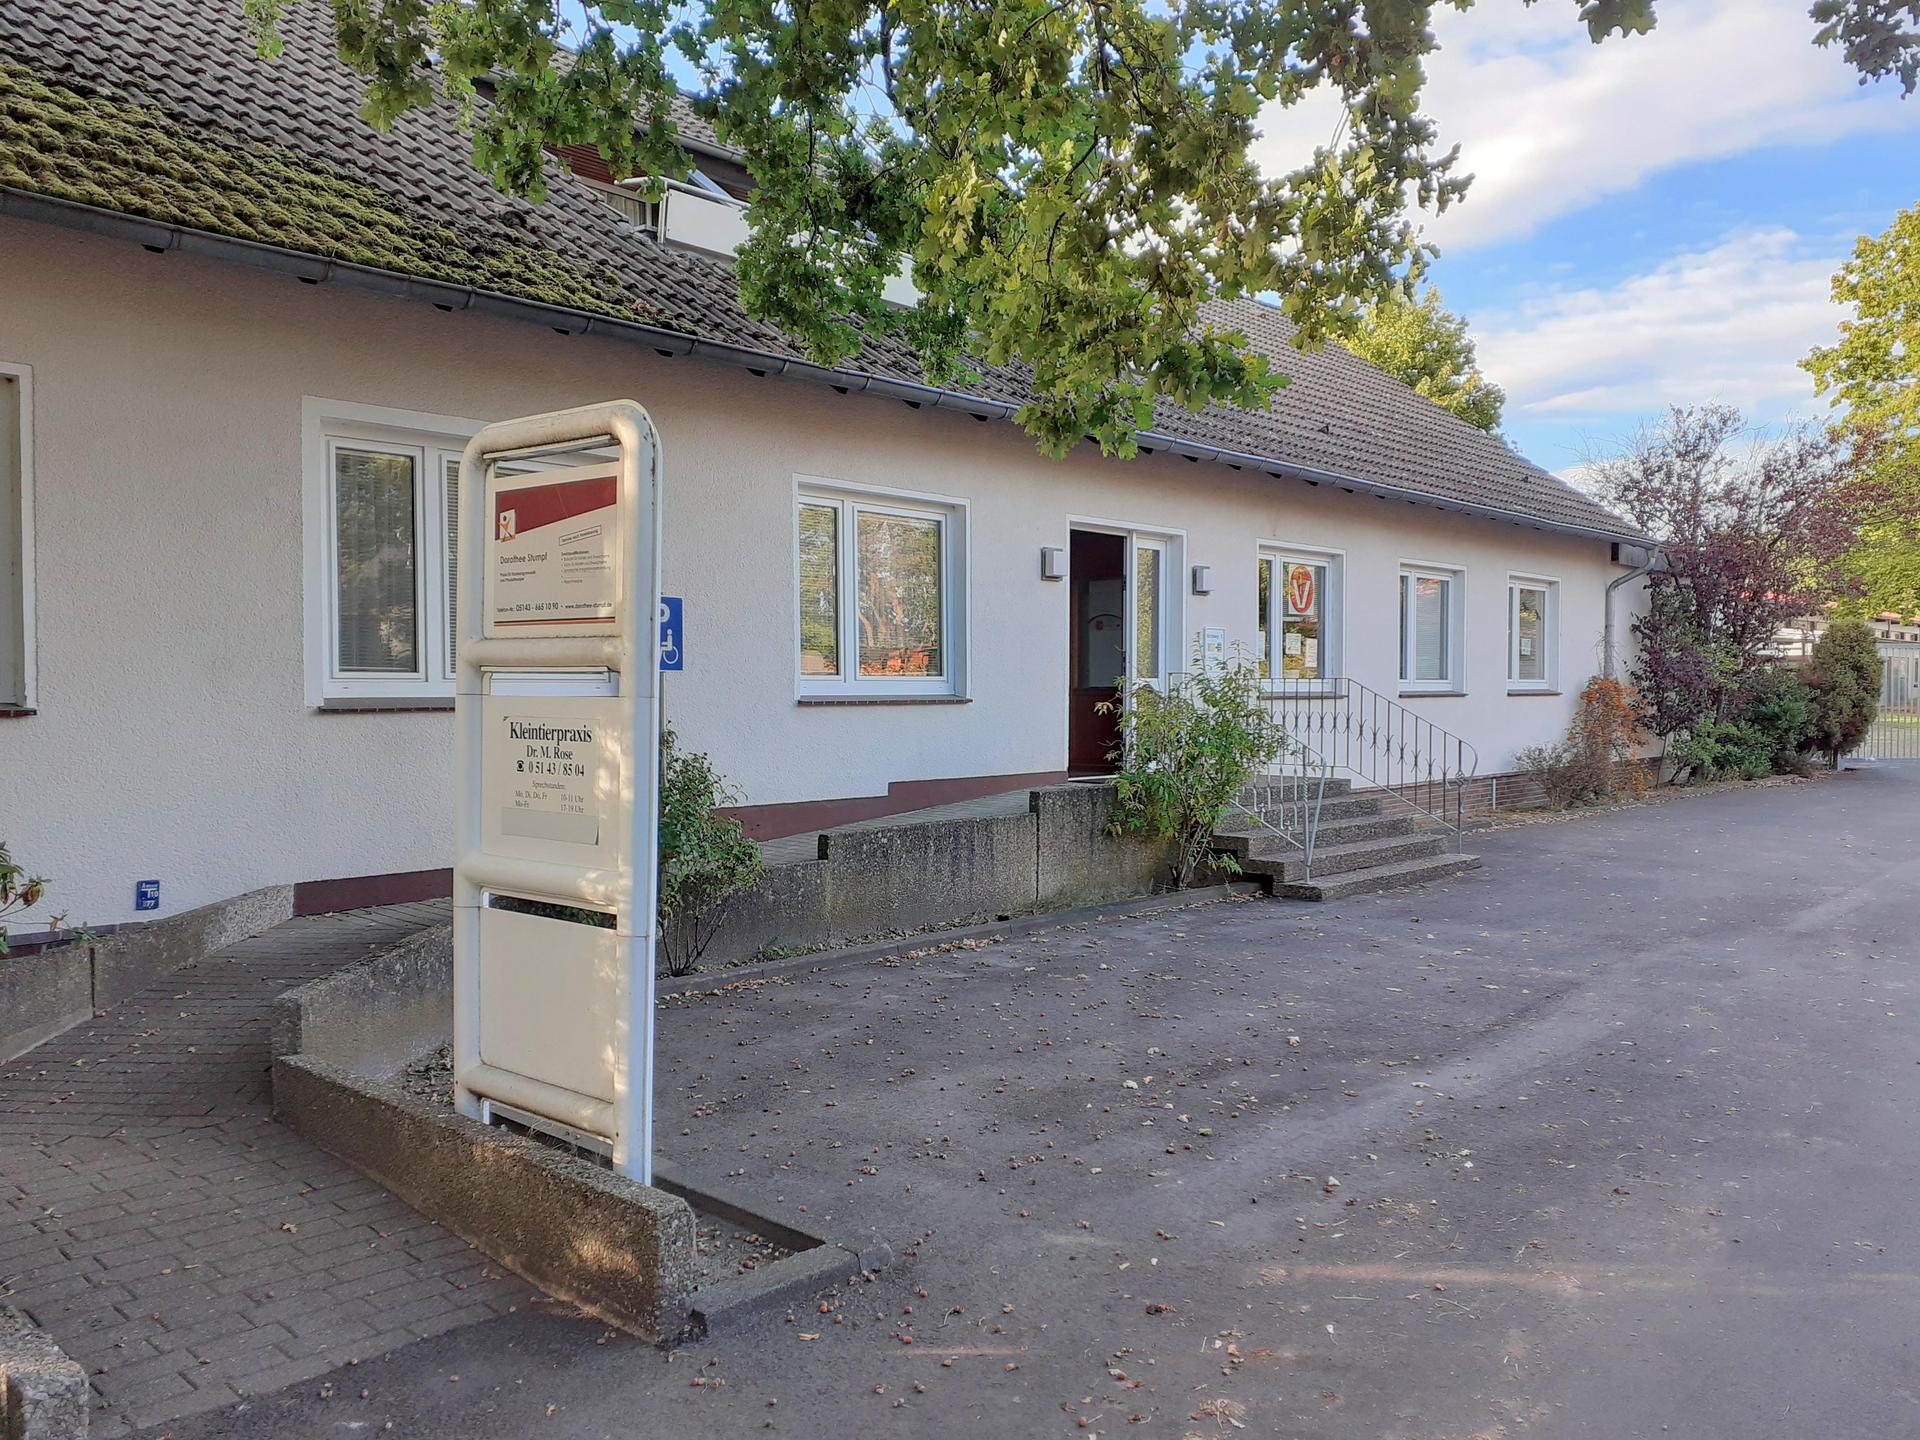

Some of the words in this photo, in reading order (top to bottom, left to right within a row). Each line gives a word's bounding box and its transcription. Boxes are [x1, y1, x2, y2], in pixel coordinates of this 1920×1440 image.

[500, 555, 526, 565] Dorothee
[528, 551, 547, 562] Stumpf
[516, 603, 531, 612] 05143
[535, 602, 544, 611] 665
[545, 602, 551, 610] 10
[552, 601, 559, 610] 90
[509, 721, 592, 746] Kleintierpraxis
[526, 744, 538, 757] Dr.
[541, 745, 552, 759] M.
[553, 746, 573, 760] Rose
[528, 760, 533, 773] 0
[535, 761, 543, 774] 51
[547, 762, 556, 775] 43
[562, 763, 572, 776] 85
[575, 763, 585, 777] 04
